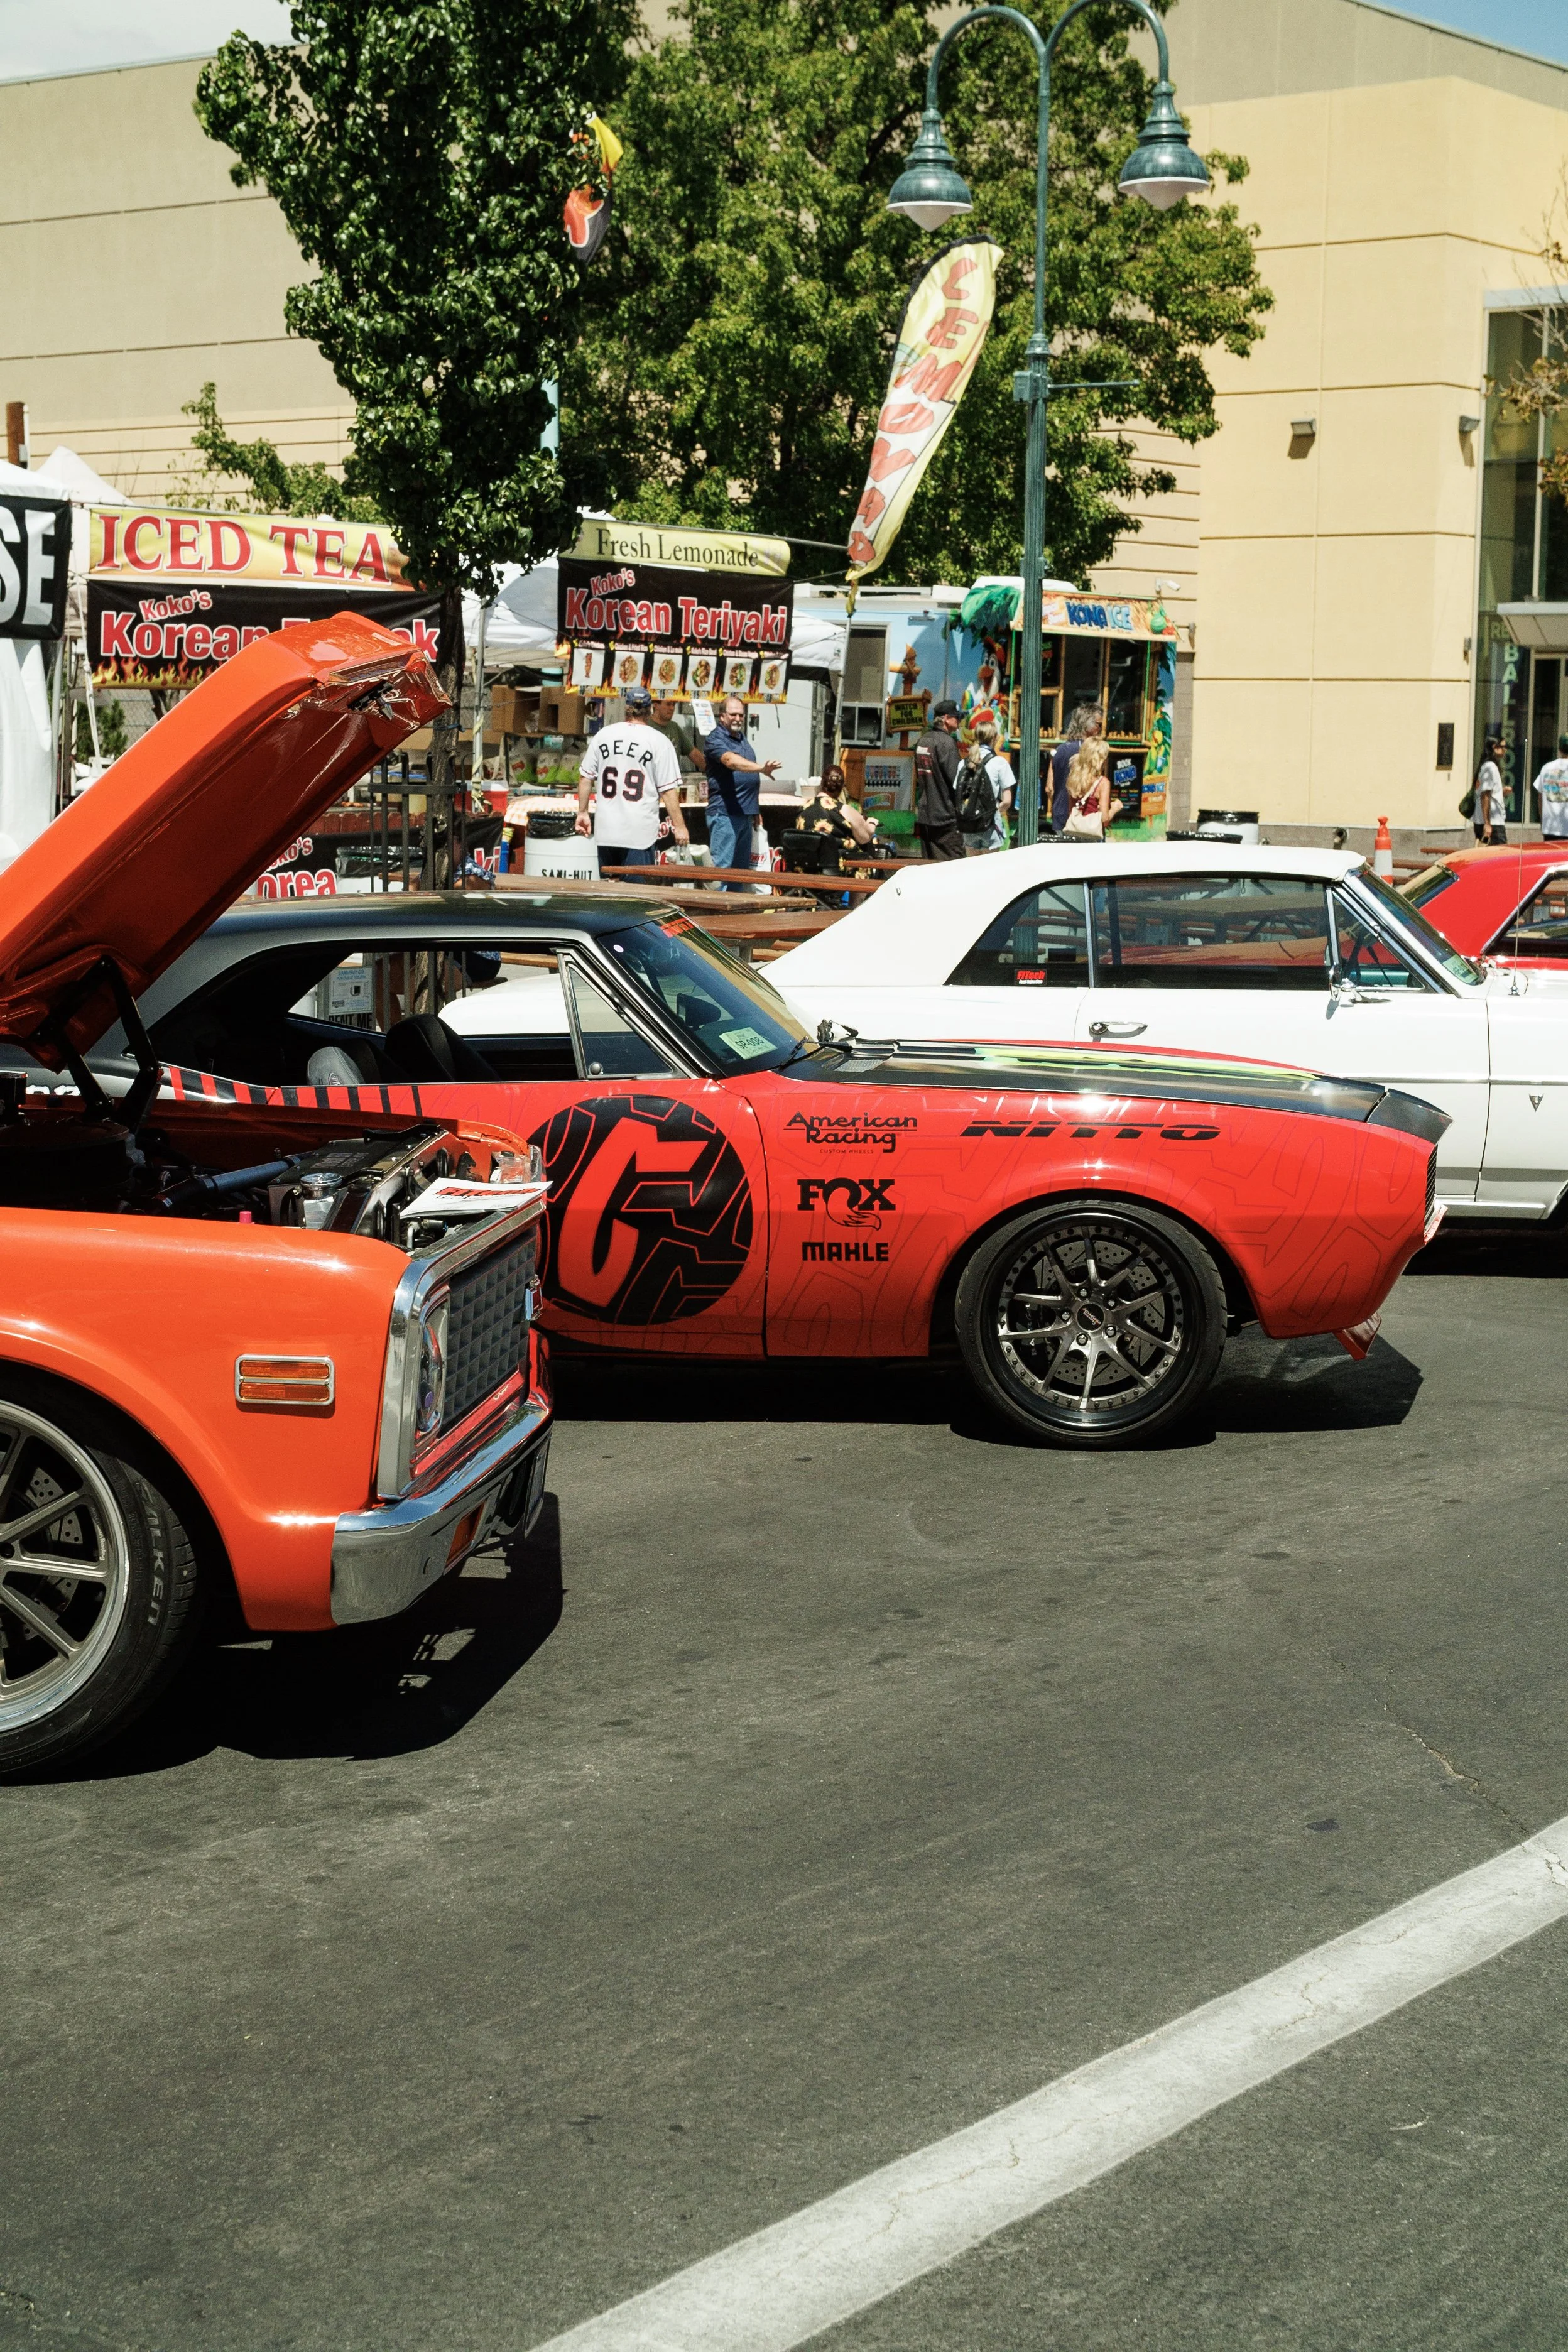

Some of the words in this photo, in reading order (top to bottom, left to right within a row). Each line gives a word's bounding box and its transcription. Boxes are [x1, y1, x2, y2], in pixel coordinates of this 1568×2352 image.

[97, 514, 253, 574] ICED
[269, 525, 391, 584] TEA
[596, 528, 651, 559] Fresh
[658, 533, 759, 567] Lemonade
[590, 568, 636, 596] Koko's
[139, 589, 213, 623] Koko's
[565, 587, 671, 634] Korean
[678, 596, 787, 647] Teriyaki
[1065, 601, 1108, 629] KONA
[1107, 604, 1133, 631] ICE
[599, 739, 653, 767] BEER
[601, 766, 645, 802] 69
[787, 1111, 918, 1128] American
[959, 1121, 1221, 1141] NITTO
[806, 1127, 896, 1153] Racing
[797, 1177, 896, 1217] FOX
[802, 1241, 890, 1261] MAHLE
